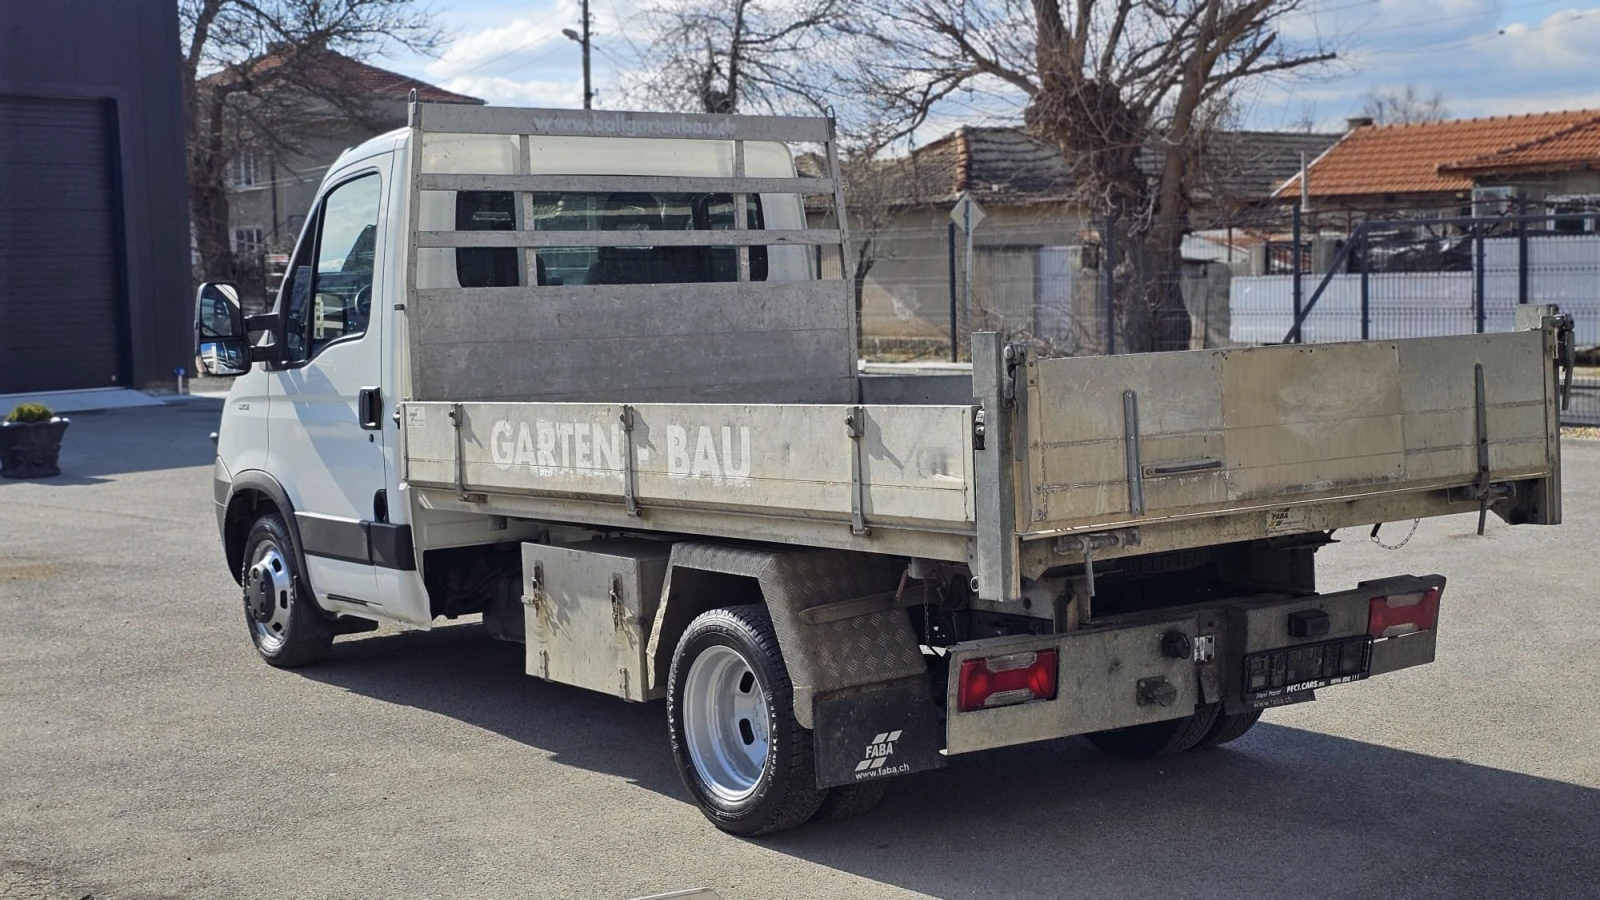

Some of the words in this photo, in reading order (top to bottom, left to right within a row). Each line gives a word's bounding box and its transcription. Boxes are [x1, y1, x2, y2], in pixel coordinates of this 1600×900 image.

[490, 419, 622, 475] GARTEN
[666, 424, 751, 482] BAU
[865, 742, 893, 759] FABA
[855, 763, 910, 780] www.faba.ch
